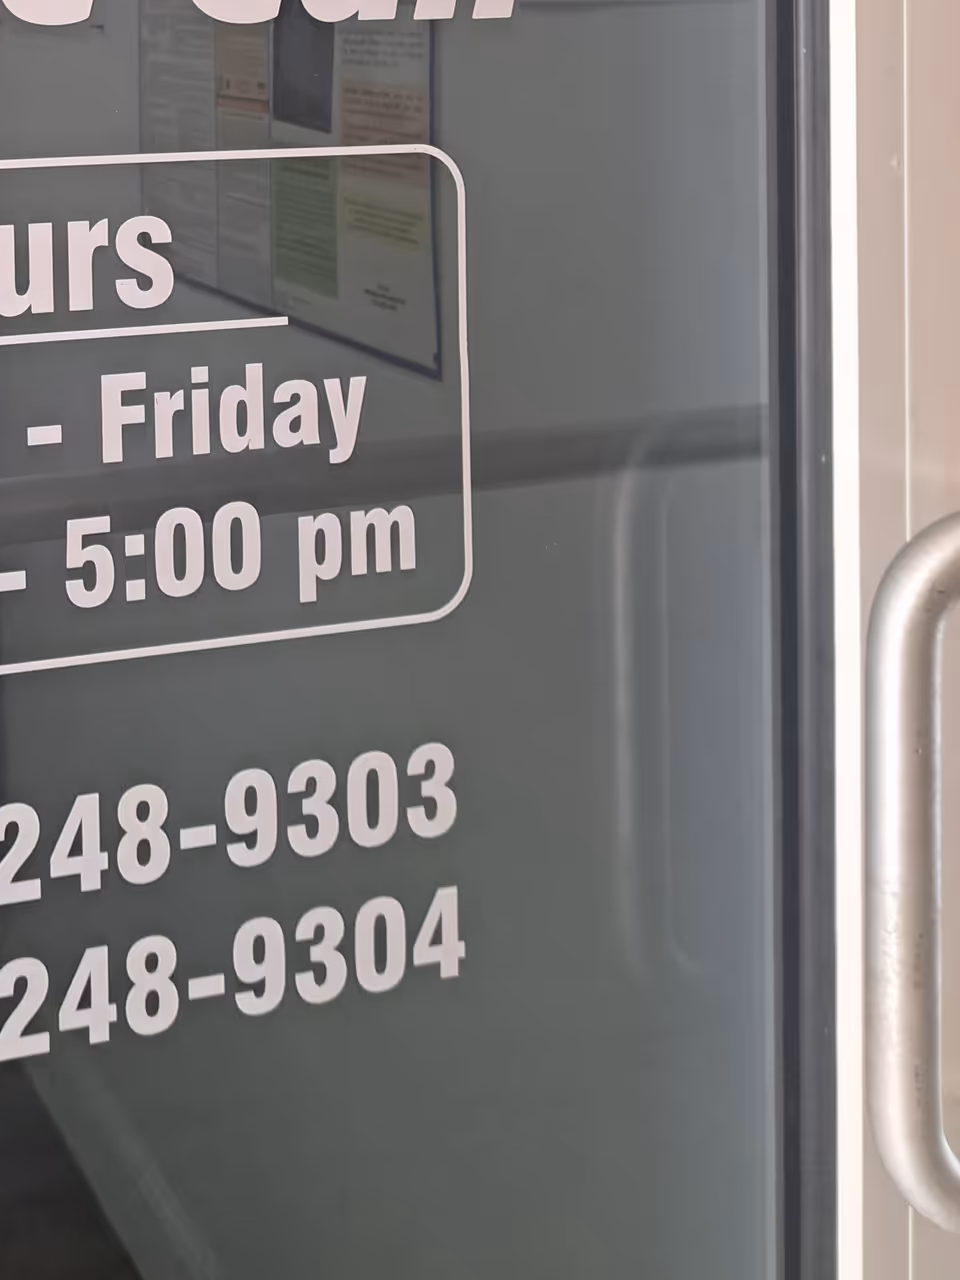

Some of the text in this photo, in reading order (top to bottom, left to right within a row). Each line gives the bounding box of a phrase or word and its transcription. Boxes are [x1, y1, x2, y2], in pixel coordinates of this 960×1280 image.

[27, 424, 63, 446] -
[100, 362, 368, 464] Friday
[65, 501, 261, 608] 5:00
[297, 505, 416, 603] pm
